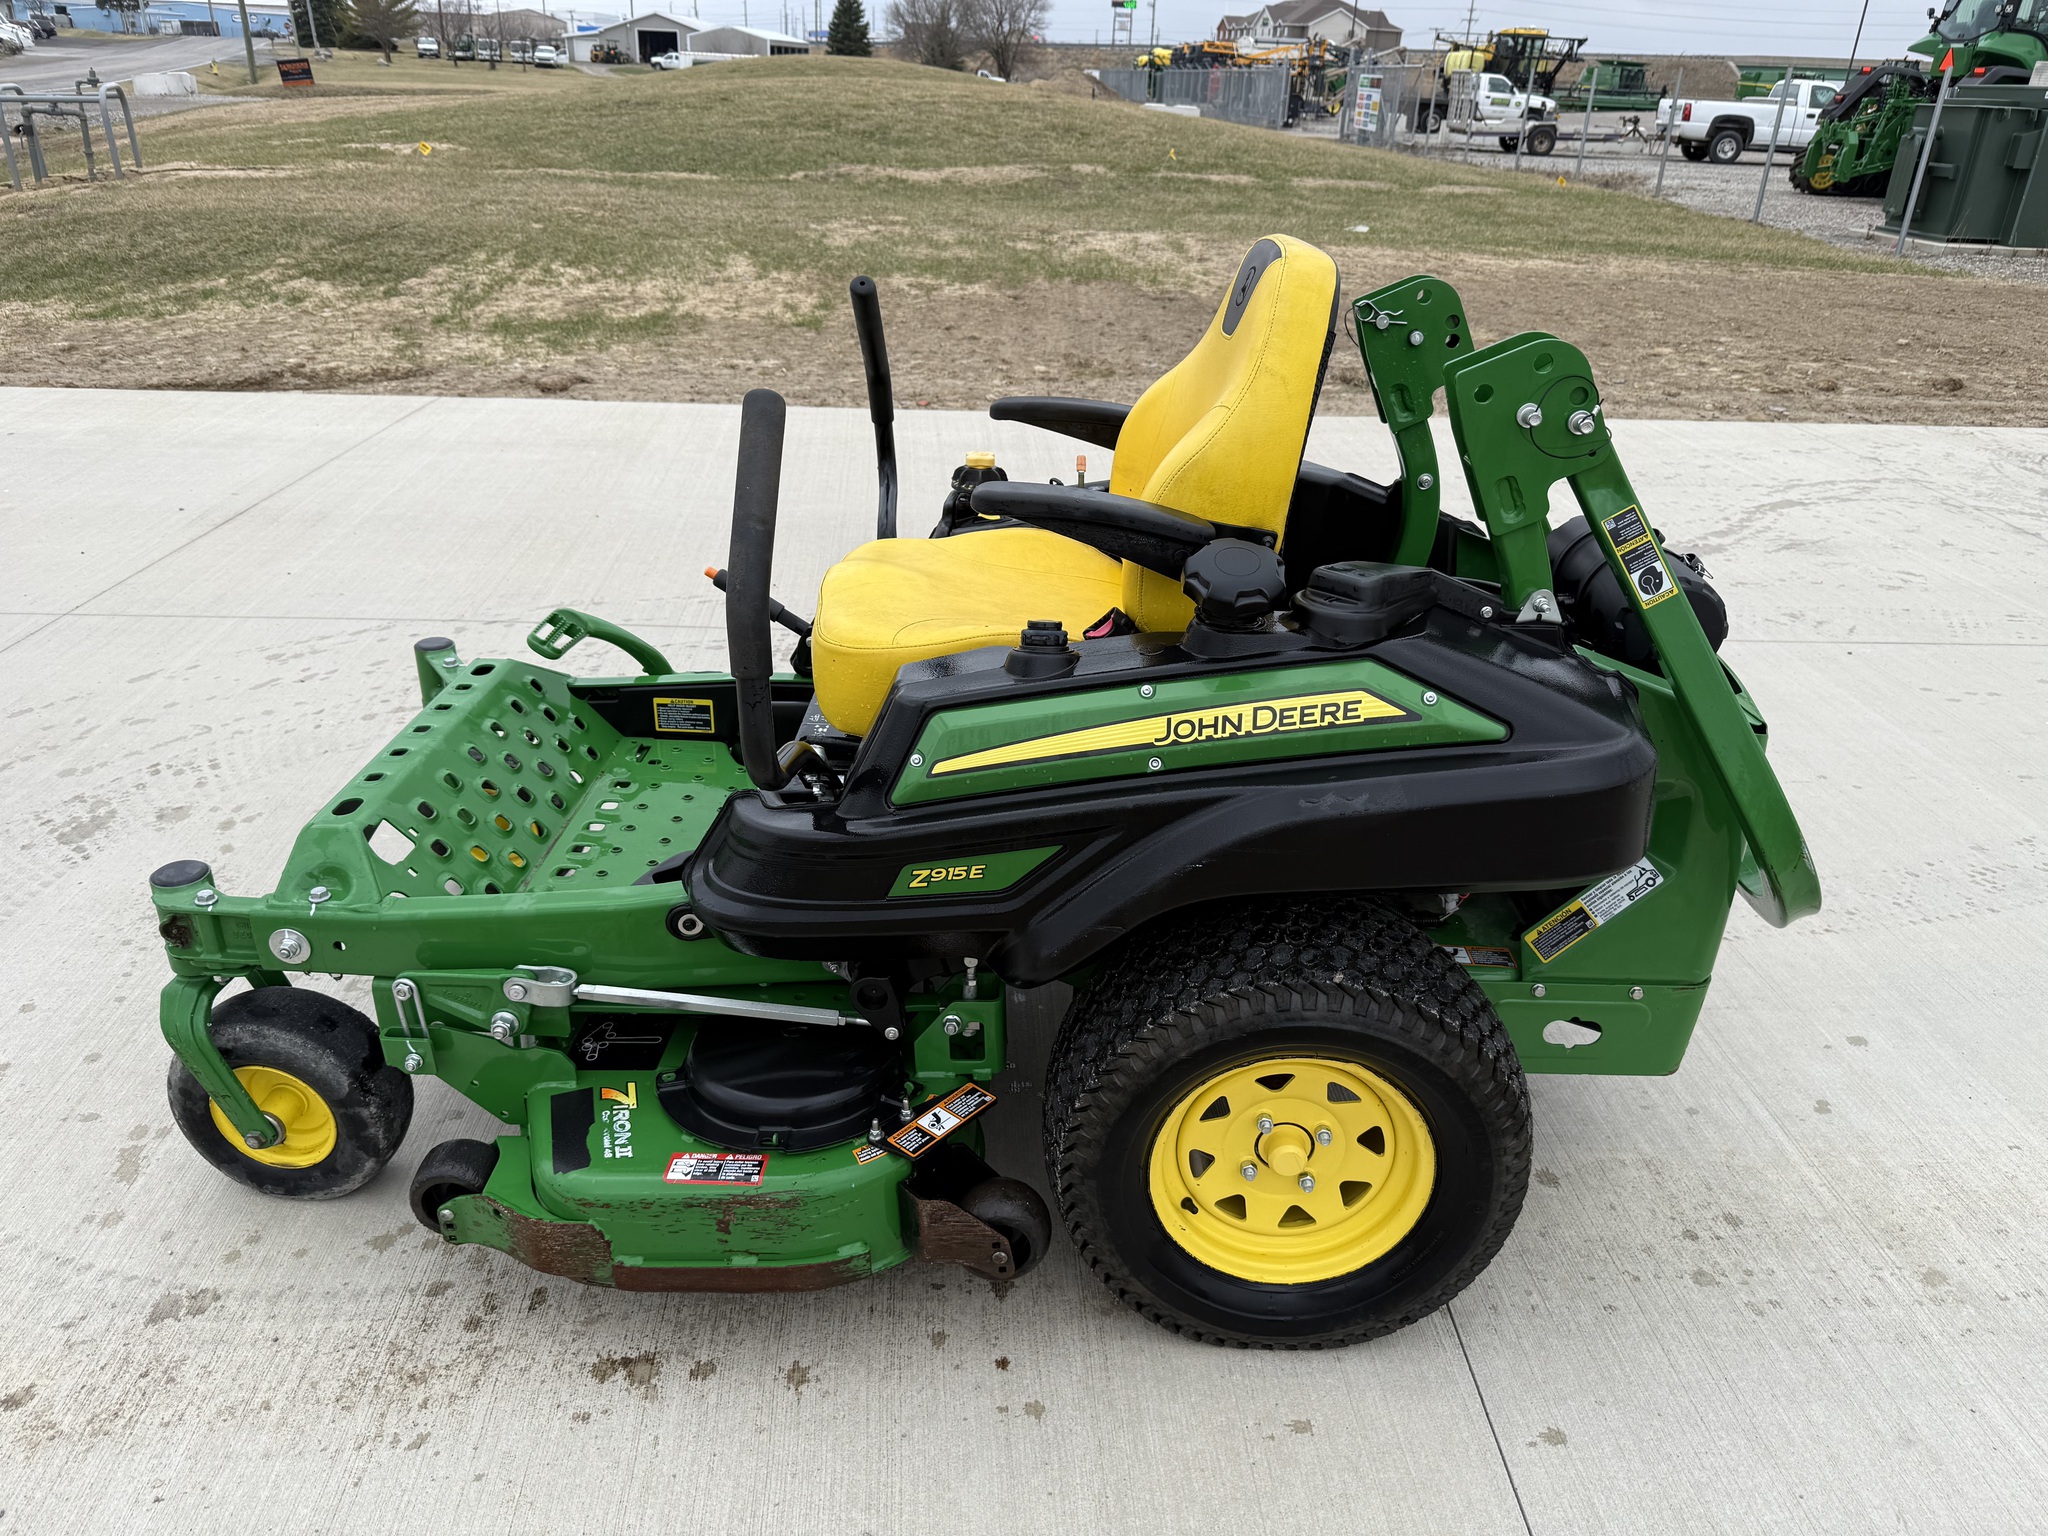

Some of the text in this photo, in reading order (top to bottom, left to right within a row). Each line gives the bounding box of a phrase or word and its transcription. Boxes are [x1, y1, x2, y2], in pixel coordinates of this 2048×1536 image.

[1617, 536, 1644, 553] ATENCIÓN
[1645, 591, 1669, 606] CAUTION
[1154, 700, 1362, 746] JOHN DEERE
[907, 864, 987, 889] Z915E
[1541, 907, 1572, 932] ATENCIÓN
